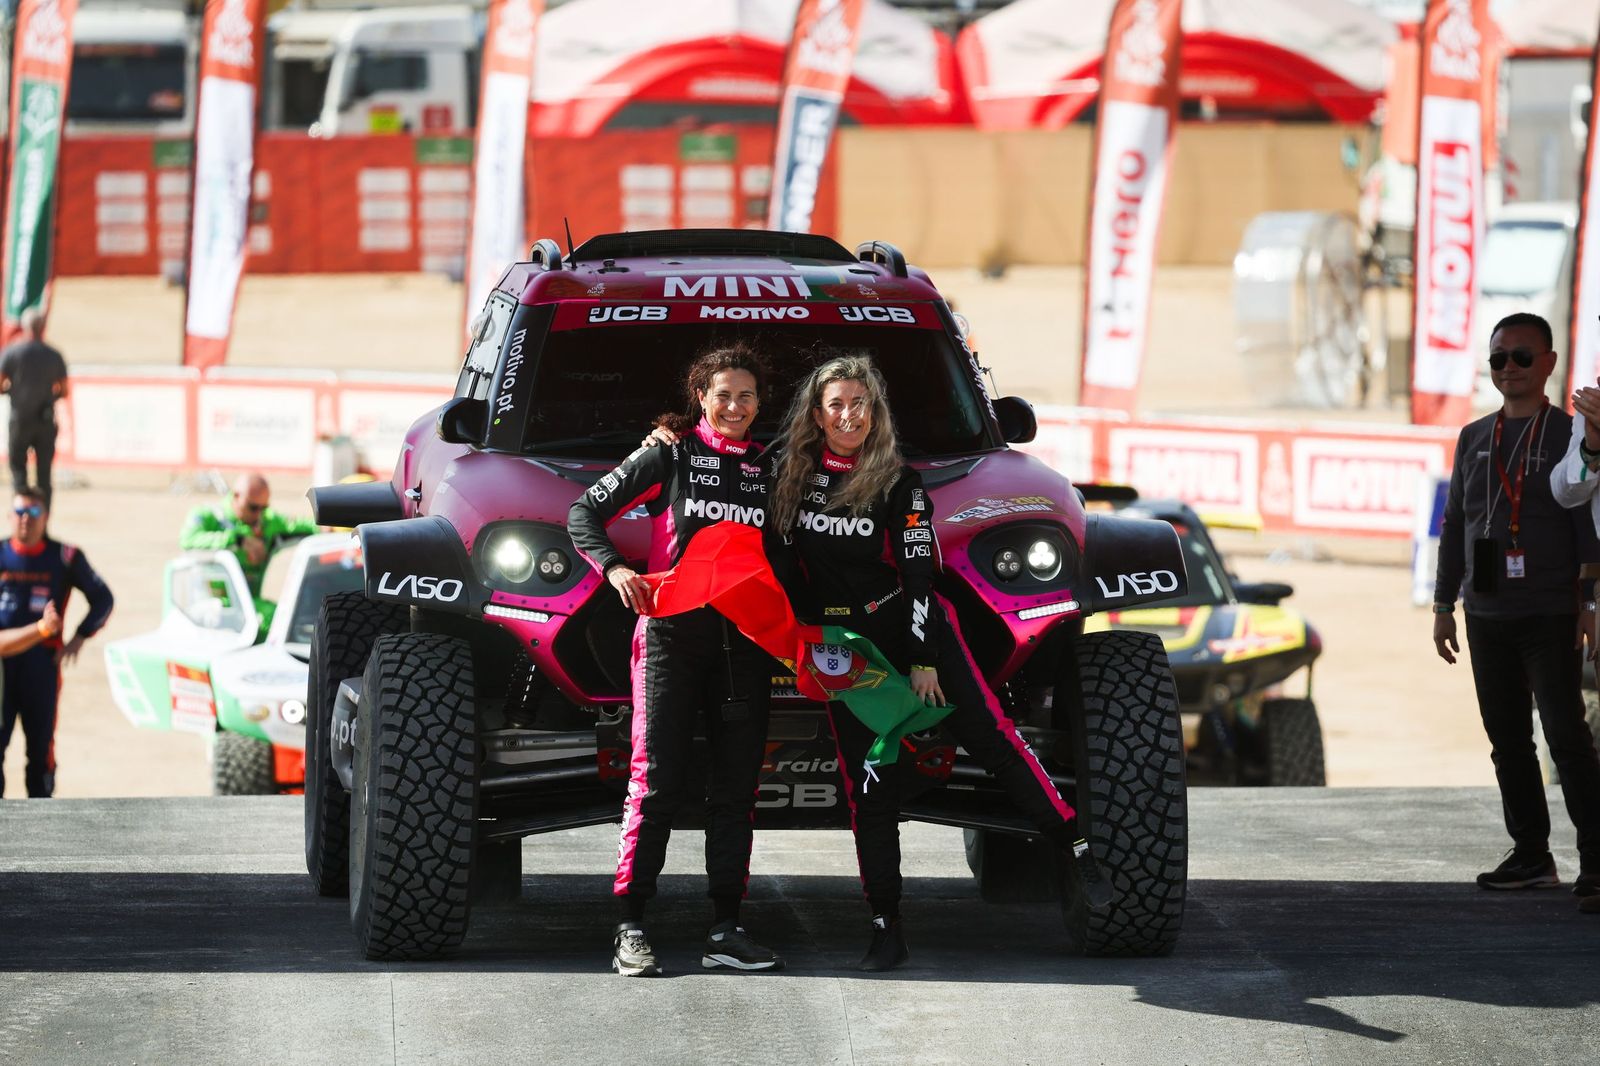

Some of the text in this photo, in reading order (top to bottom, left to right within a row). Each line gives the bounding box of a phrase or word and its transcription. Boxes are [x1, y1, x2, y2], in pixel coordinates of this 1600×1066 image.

[1429, 146, 1471, 346] MOTUL
[663, 276, 812, 298] MINI
[588, 305, 669, 323] JCB
[699, 305, 810, 320] MOTIVO
[838, 305, 916, 324] JCB
[496, 328, 528, 415] motivo.pt
[691, 456, 719, 468] JCB
[689, 471, 720, 486] LASO
[1312, 457, 1421, 511] MOTU
[684, 498, 765, 527] MOTIVO
[796, 509, 875, 537] MOTIVO
[905, 530, 930, 542] JCB
[904, 545, 931, 559] LASO
[377, 572, 464, 602] LASO
[1095, 569, 1179, 599] LASO
[754, 784, 838, 808] CB
